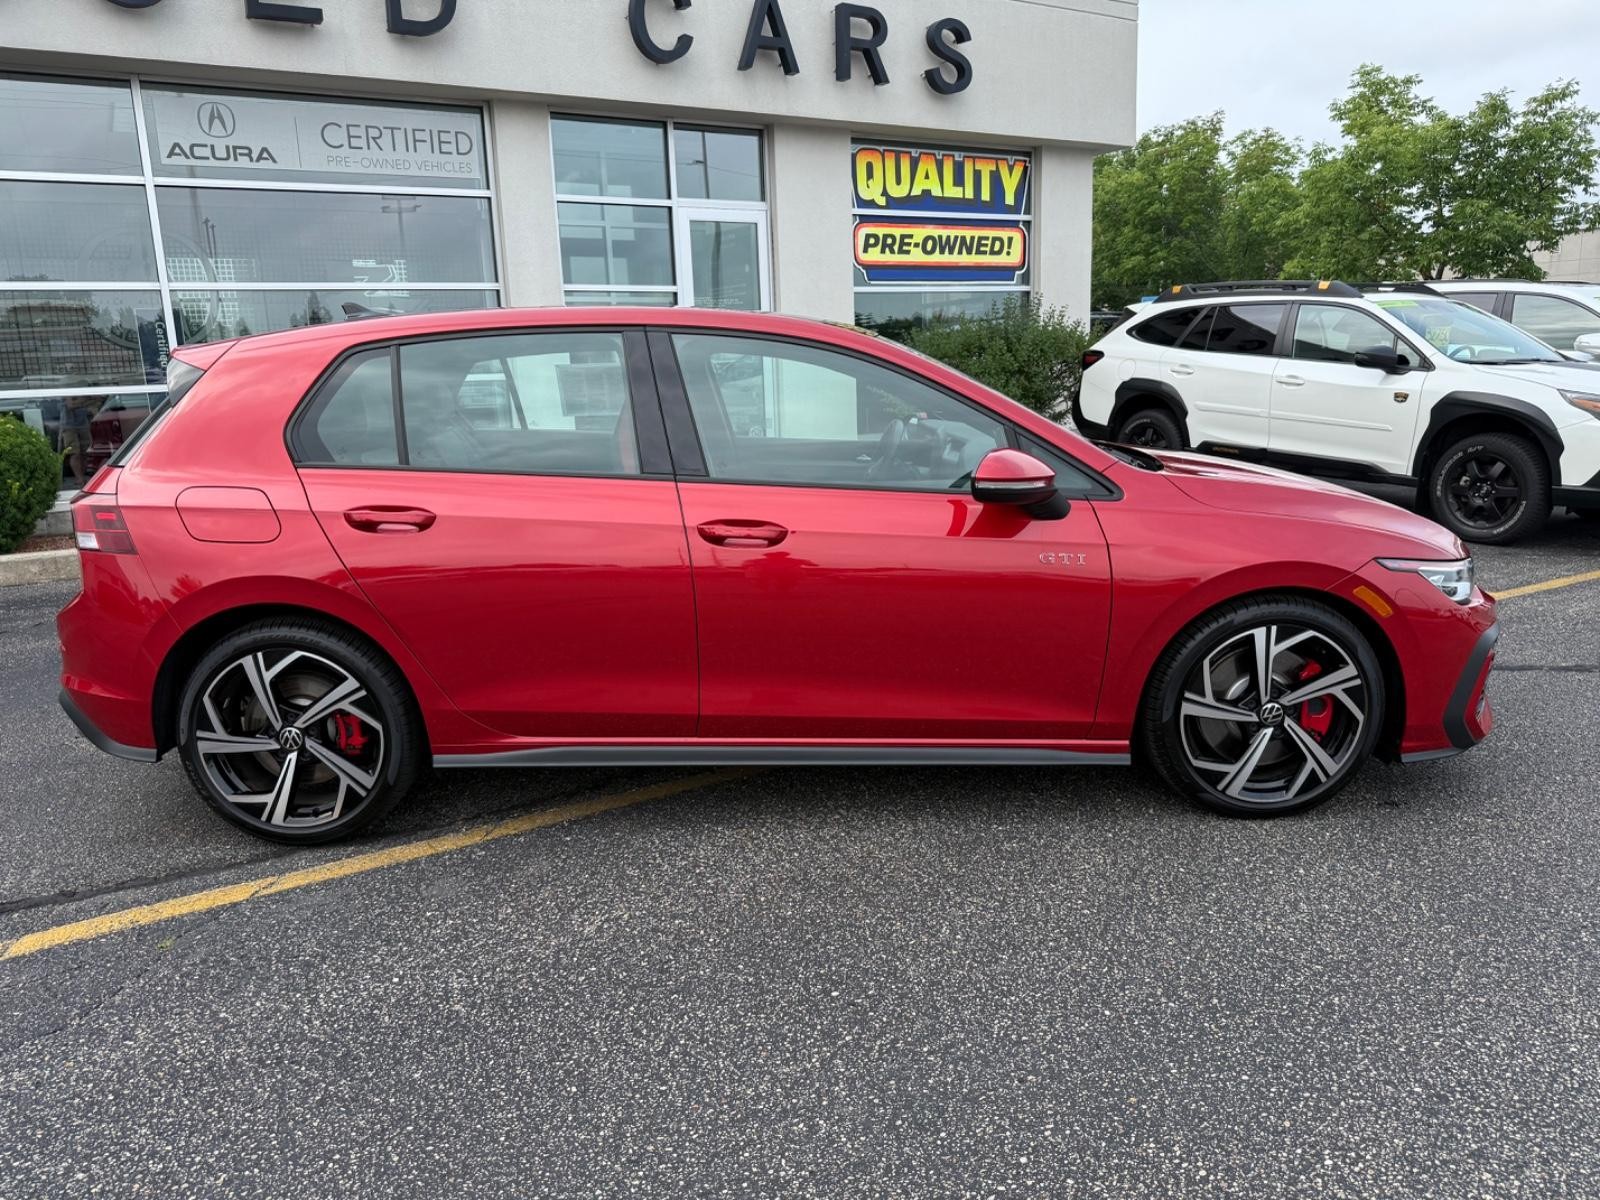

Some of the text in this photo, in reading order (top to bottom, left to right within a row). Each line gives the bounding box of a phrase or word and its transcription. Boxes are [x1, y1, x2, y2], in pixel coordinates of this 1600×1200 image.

[628, 0, 973, 95] CARS
[320, 121, 473, 156] CERTIFIED
[166, 142, 278, 164] ACURA
[326, 155, 473, 174] PRE-OWNED VEHICLES
[855, 147, 1025, 206] QUALITY
[862, 232, 1014, 257] PRE-OWNED!
[1039, 552, 1087, 565] GTI
